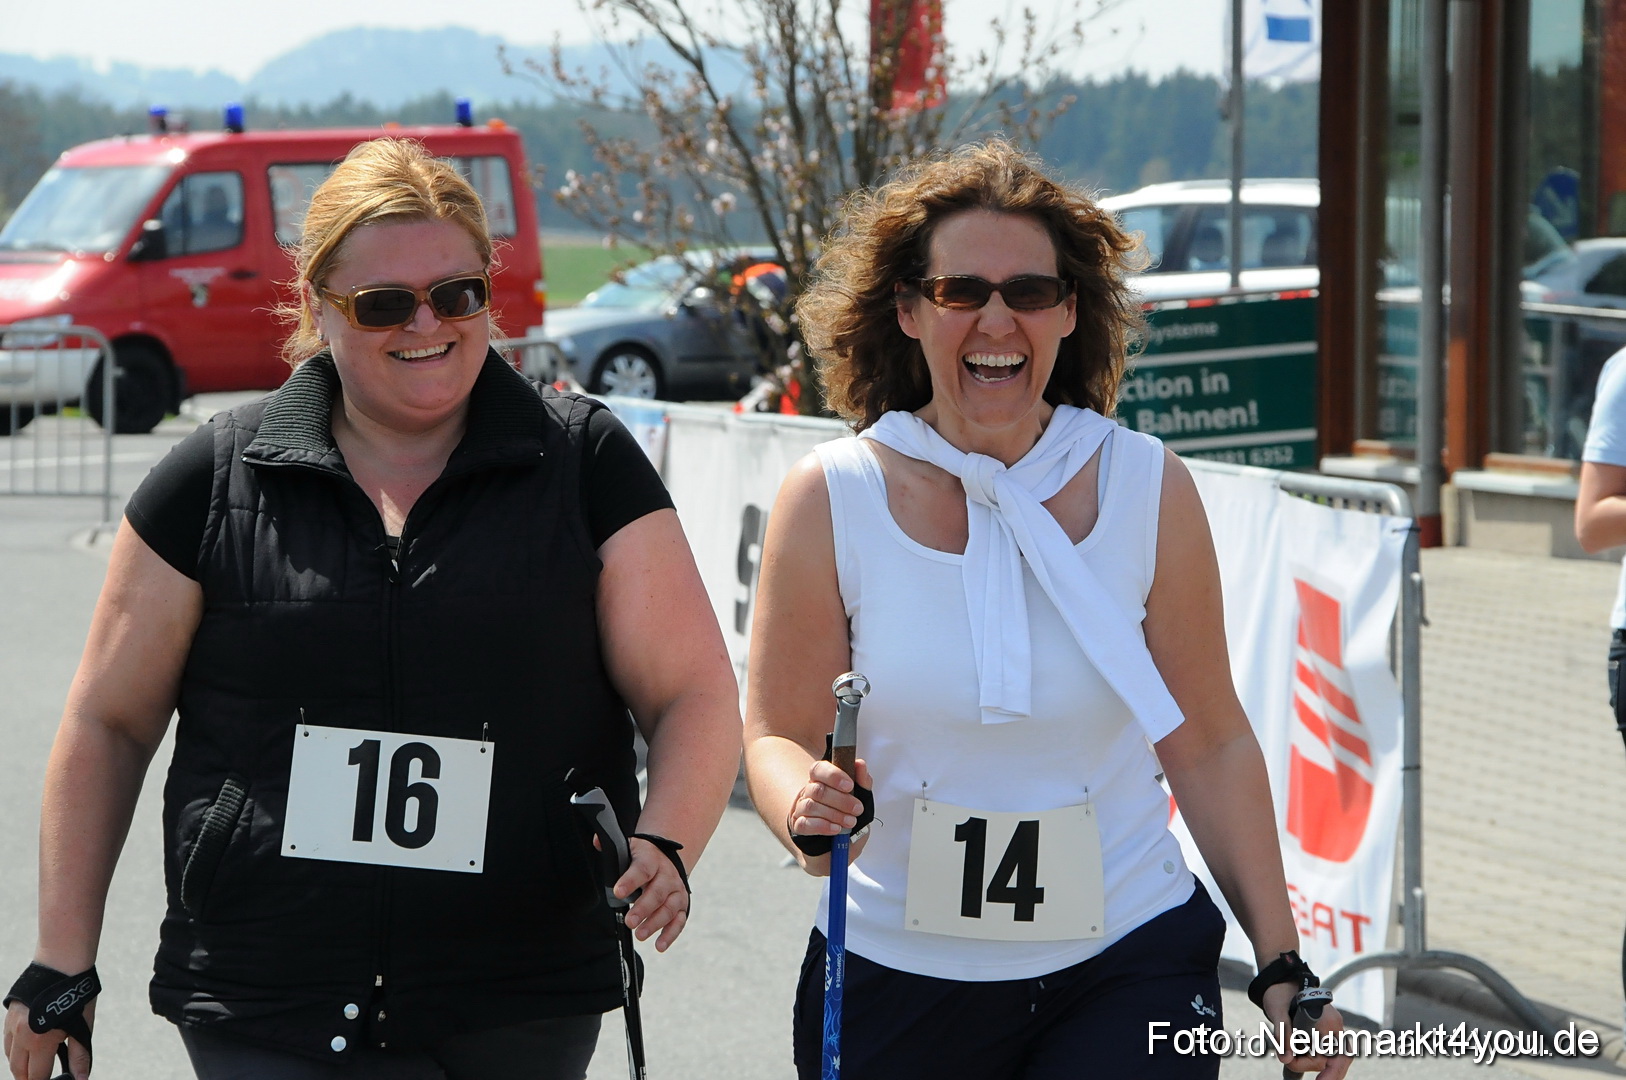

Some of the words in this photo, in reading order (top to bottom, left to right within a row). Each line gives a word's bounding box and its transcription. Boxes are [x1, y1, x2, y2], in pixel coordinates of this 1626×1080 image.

[1123, 372, 1194, 400] ction
[1200, 366, 1230, 396] in
[1136, 399, 1259, 434] Bahnen!
[348, 739, 441, 849] 16
[954, 816, 1044, 922] 14
[37, 1015, 46, 1026] R
